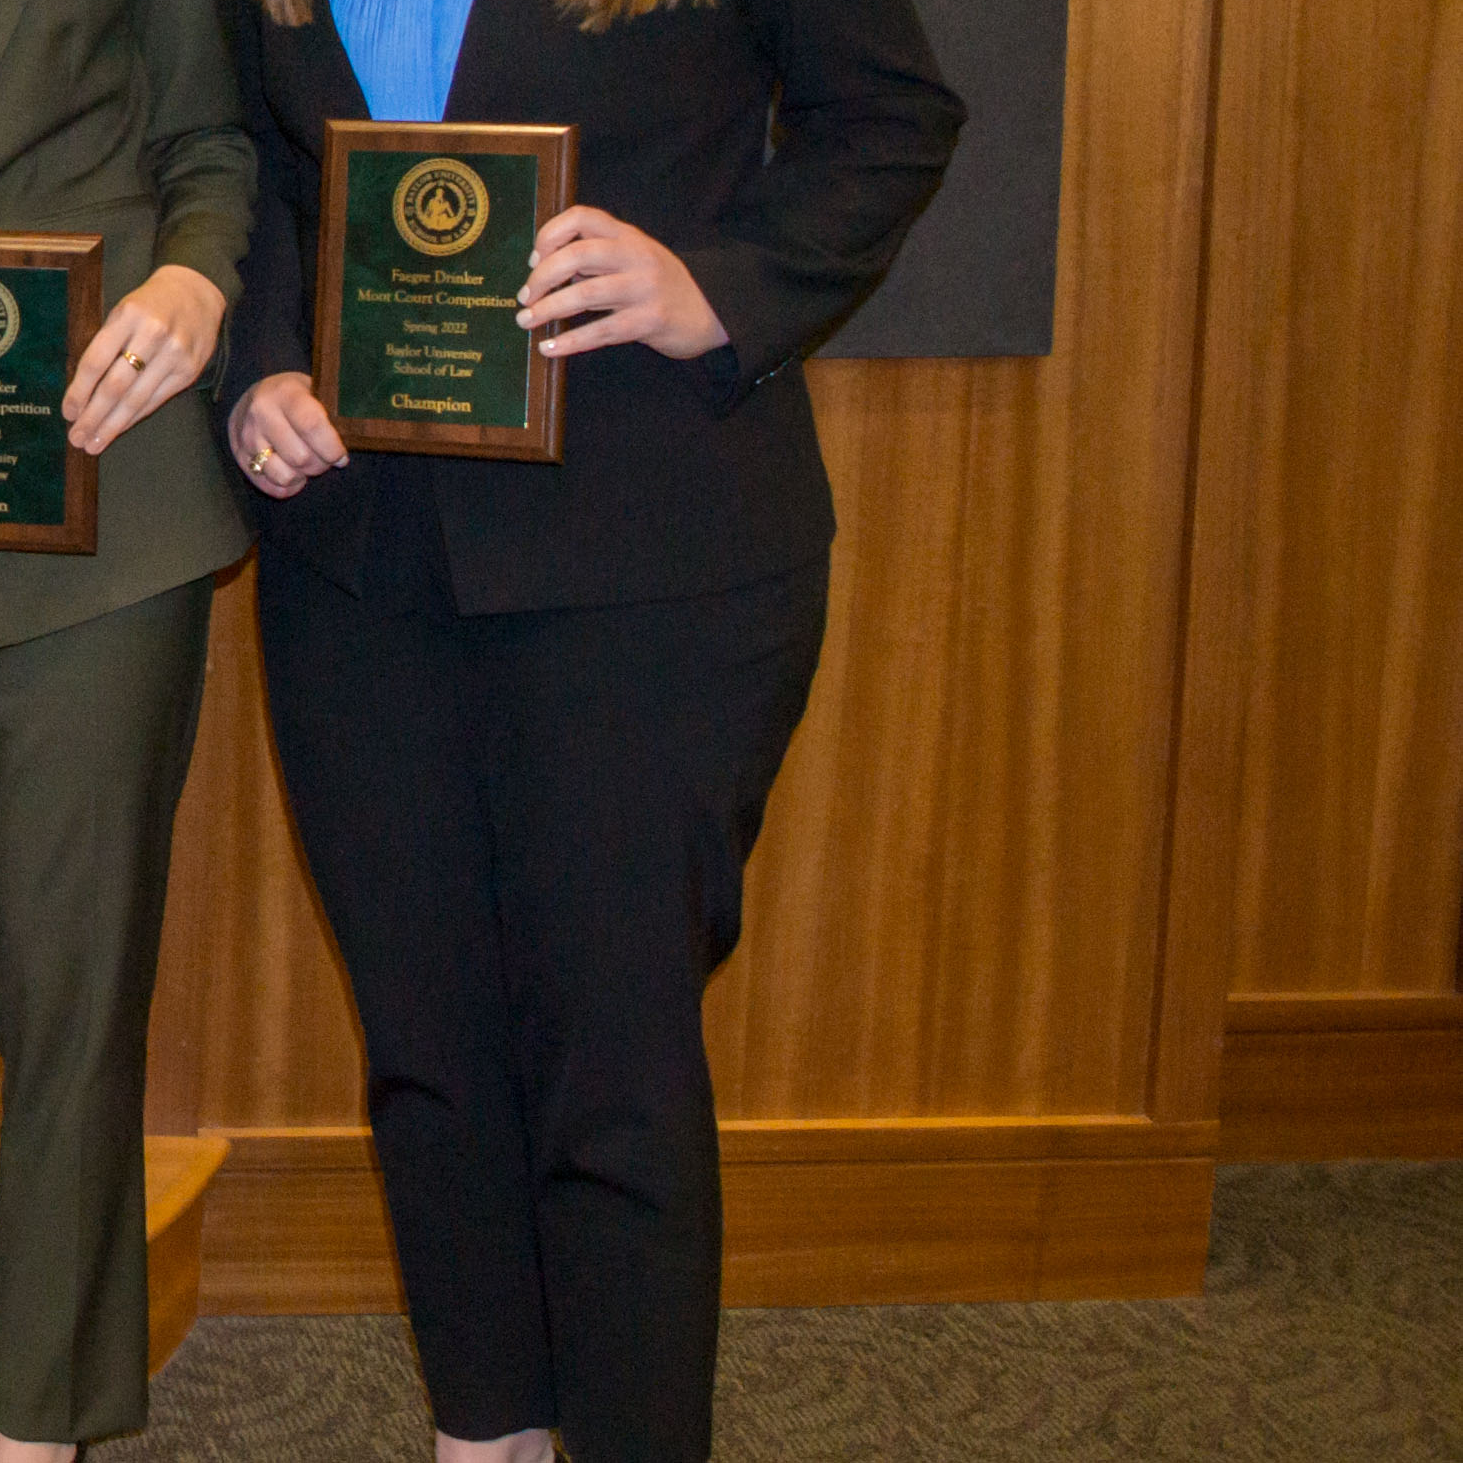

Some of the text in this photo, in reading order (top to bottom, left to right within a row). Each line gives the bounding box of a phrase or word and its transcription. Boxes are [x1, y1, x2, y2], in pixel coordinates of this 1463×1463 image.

[435, 270, 484, 286] Drinker
[357, 288, 517, 309] Moot Court Competition
[403, 320, 438, 335] Spring
[385, 343, 483, 363] Baylor University
[393, 362, 473, 378] School of Law
[391, 394, 473, 413] Champion
